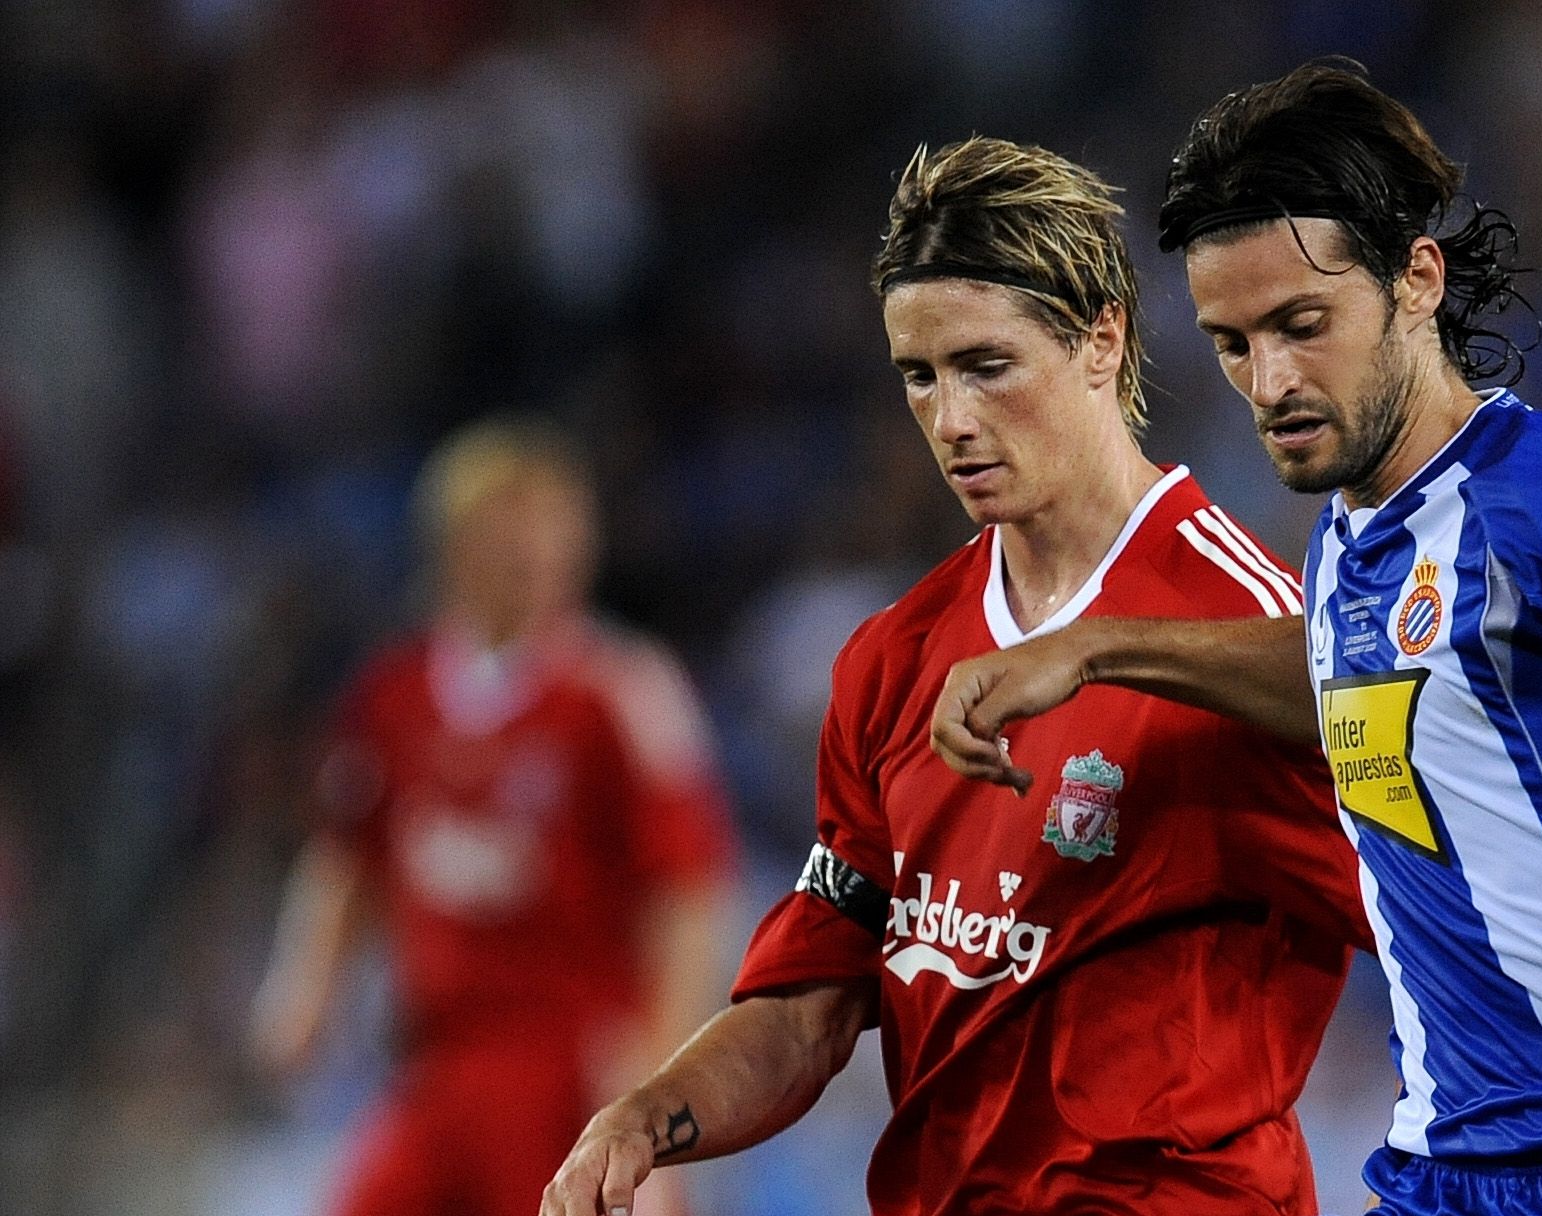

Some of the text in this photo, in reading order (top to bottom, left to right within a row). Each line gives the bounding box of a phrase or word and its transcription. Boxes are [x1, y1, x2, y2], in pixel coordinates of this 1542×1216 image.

[1328, 716, 1367, 750] Inter
[1336, 751, 1404, 792] apuestas
[1386, 782, 1413, 804] .com
[886, 871, 1052, 984] rlsberg
